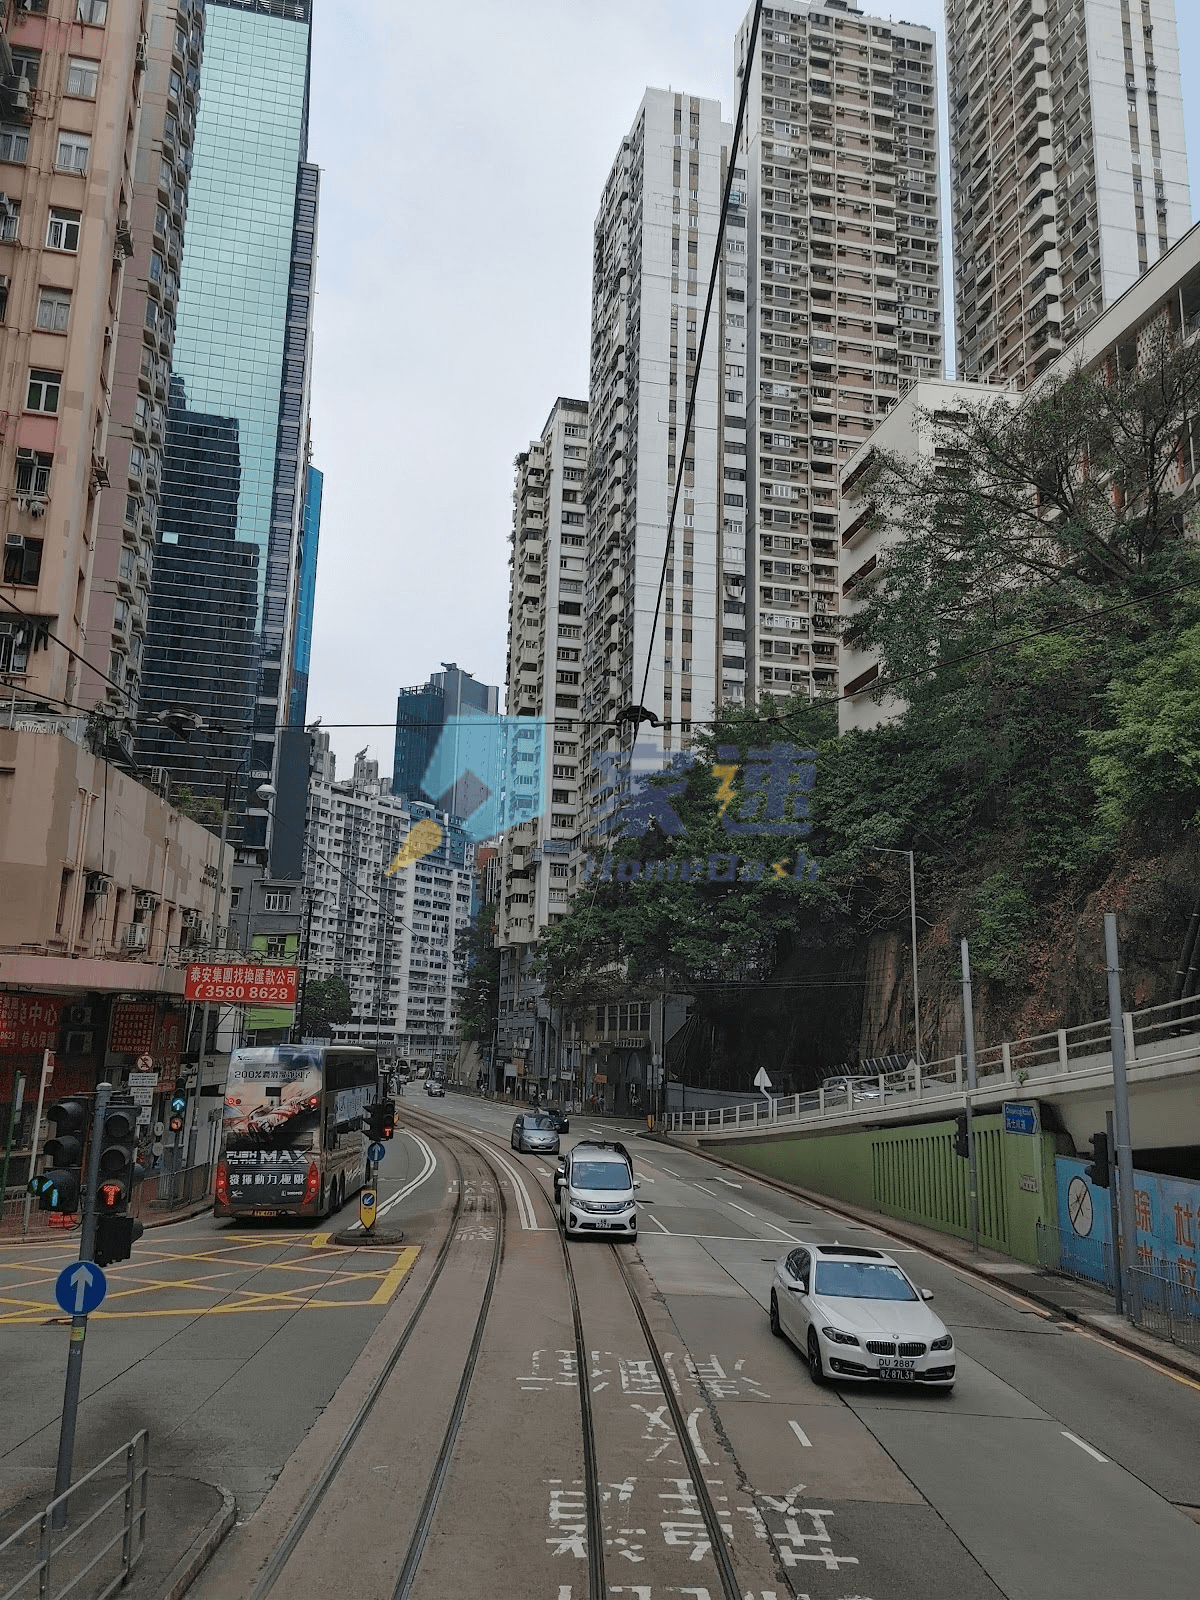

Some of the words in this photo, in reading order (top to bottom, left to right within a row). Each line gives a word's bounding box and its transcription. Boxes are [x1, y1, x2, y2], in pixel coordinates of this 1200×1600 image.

[205, 985, 244, 998] 3580
[249, 986, 288, 999] 8628
[226, 1150, 257, 1158] PUSH
[260, 1150, 309, 1164] MAX
[229, 1173, 305, 1186] 發揮動力極限
[879, 1358, 891, 1367] DU
[893, 1359, 915, 1368] 2887
